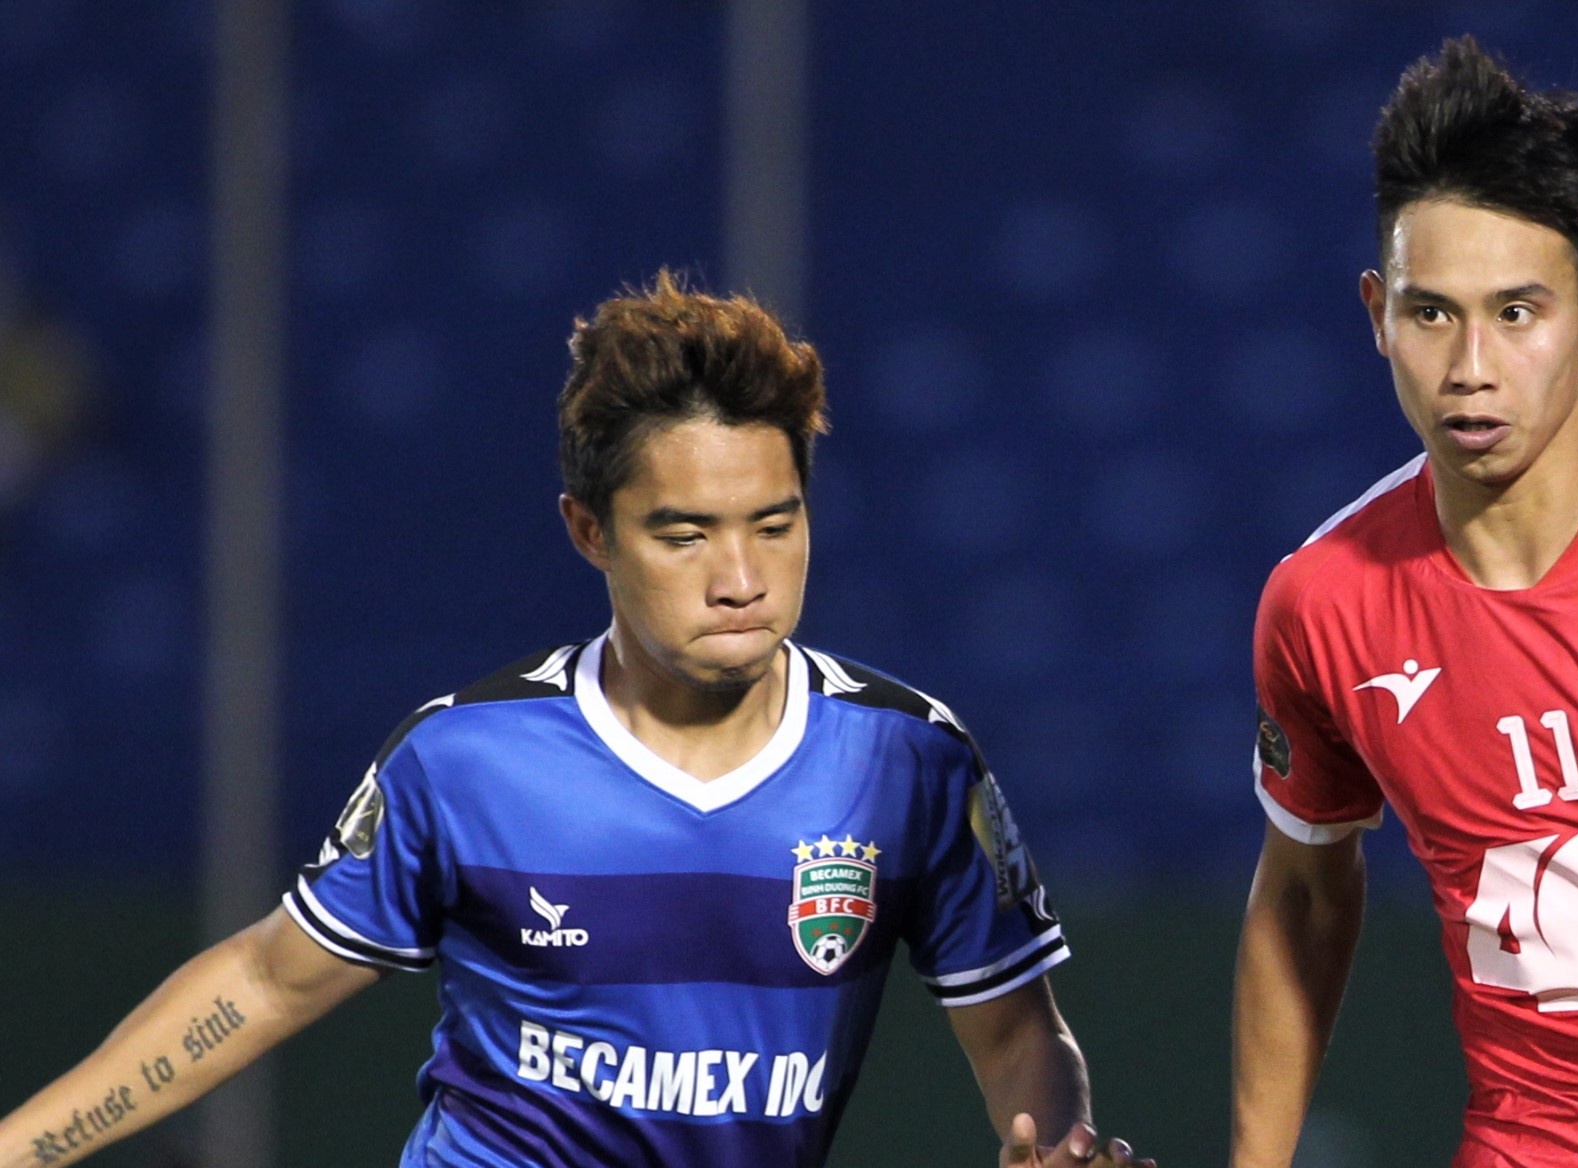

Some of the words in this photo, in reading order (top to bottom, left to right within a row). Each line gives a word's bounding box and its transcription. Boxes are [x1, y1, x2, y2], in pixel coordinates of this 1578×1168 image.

[810, 869, 863, 881] BECAMEX
[816, 898, 854, 914] BFC
[521, 928, 589, 946] KAMITO
[517, 1020, 758, 1116] BECAMEX
[32, 1085, 136, 1165] Refuse
[140, 1055, 176, 1092] to
[182, 995, 246, 1062] sink
